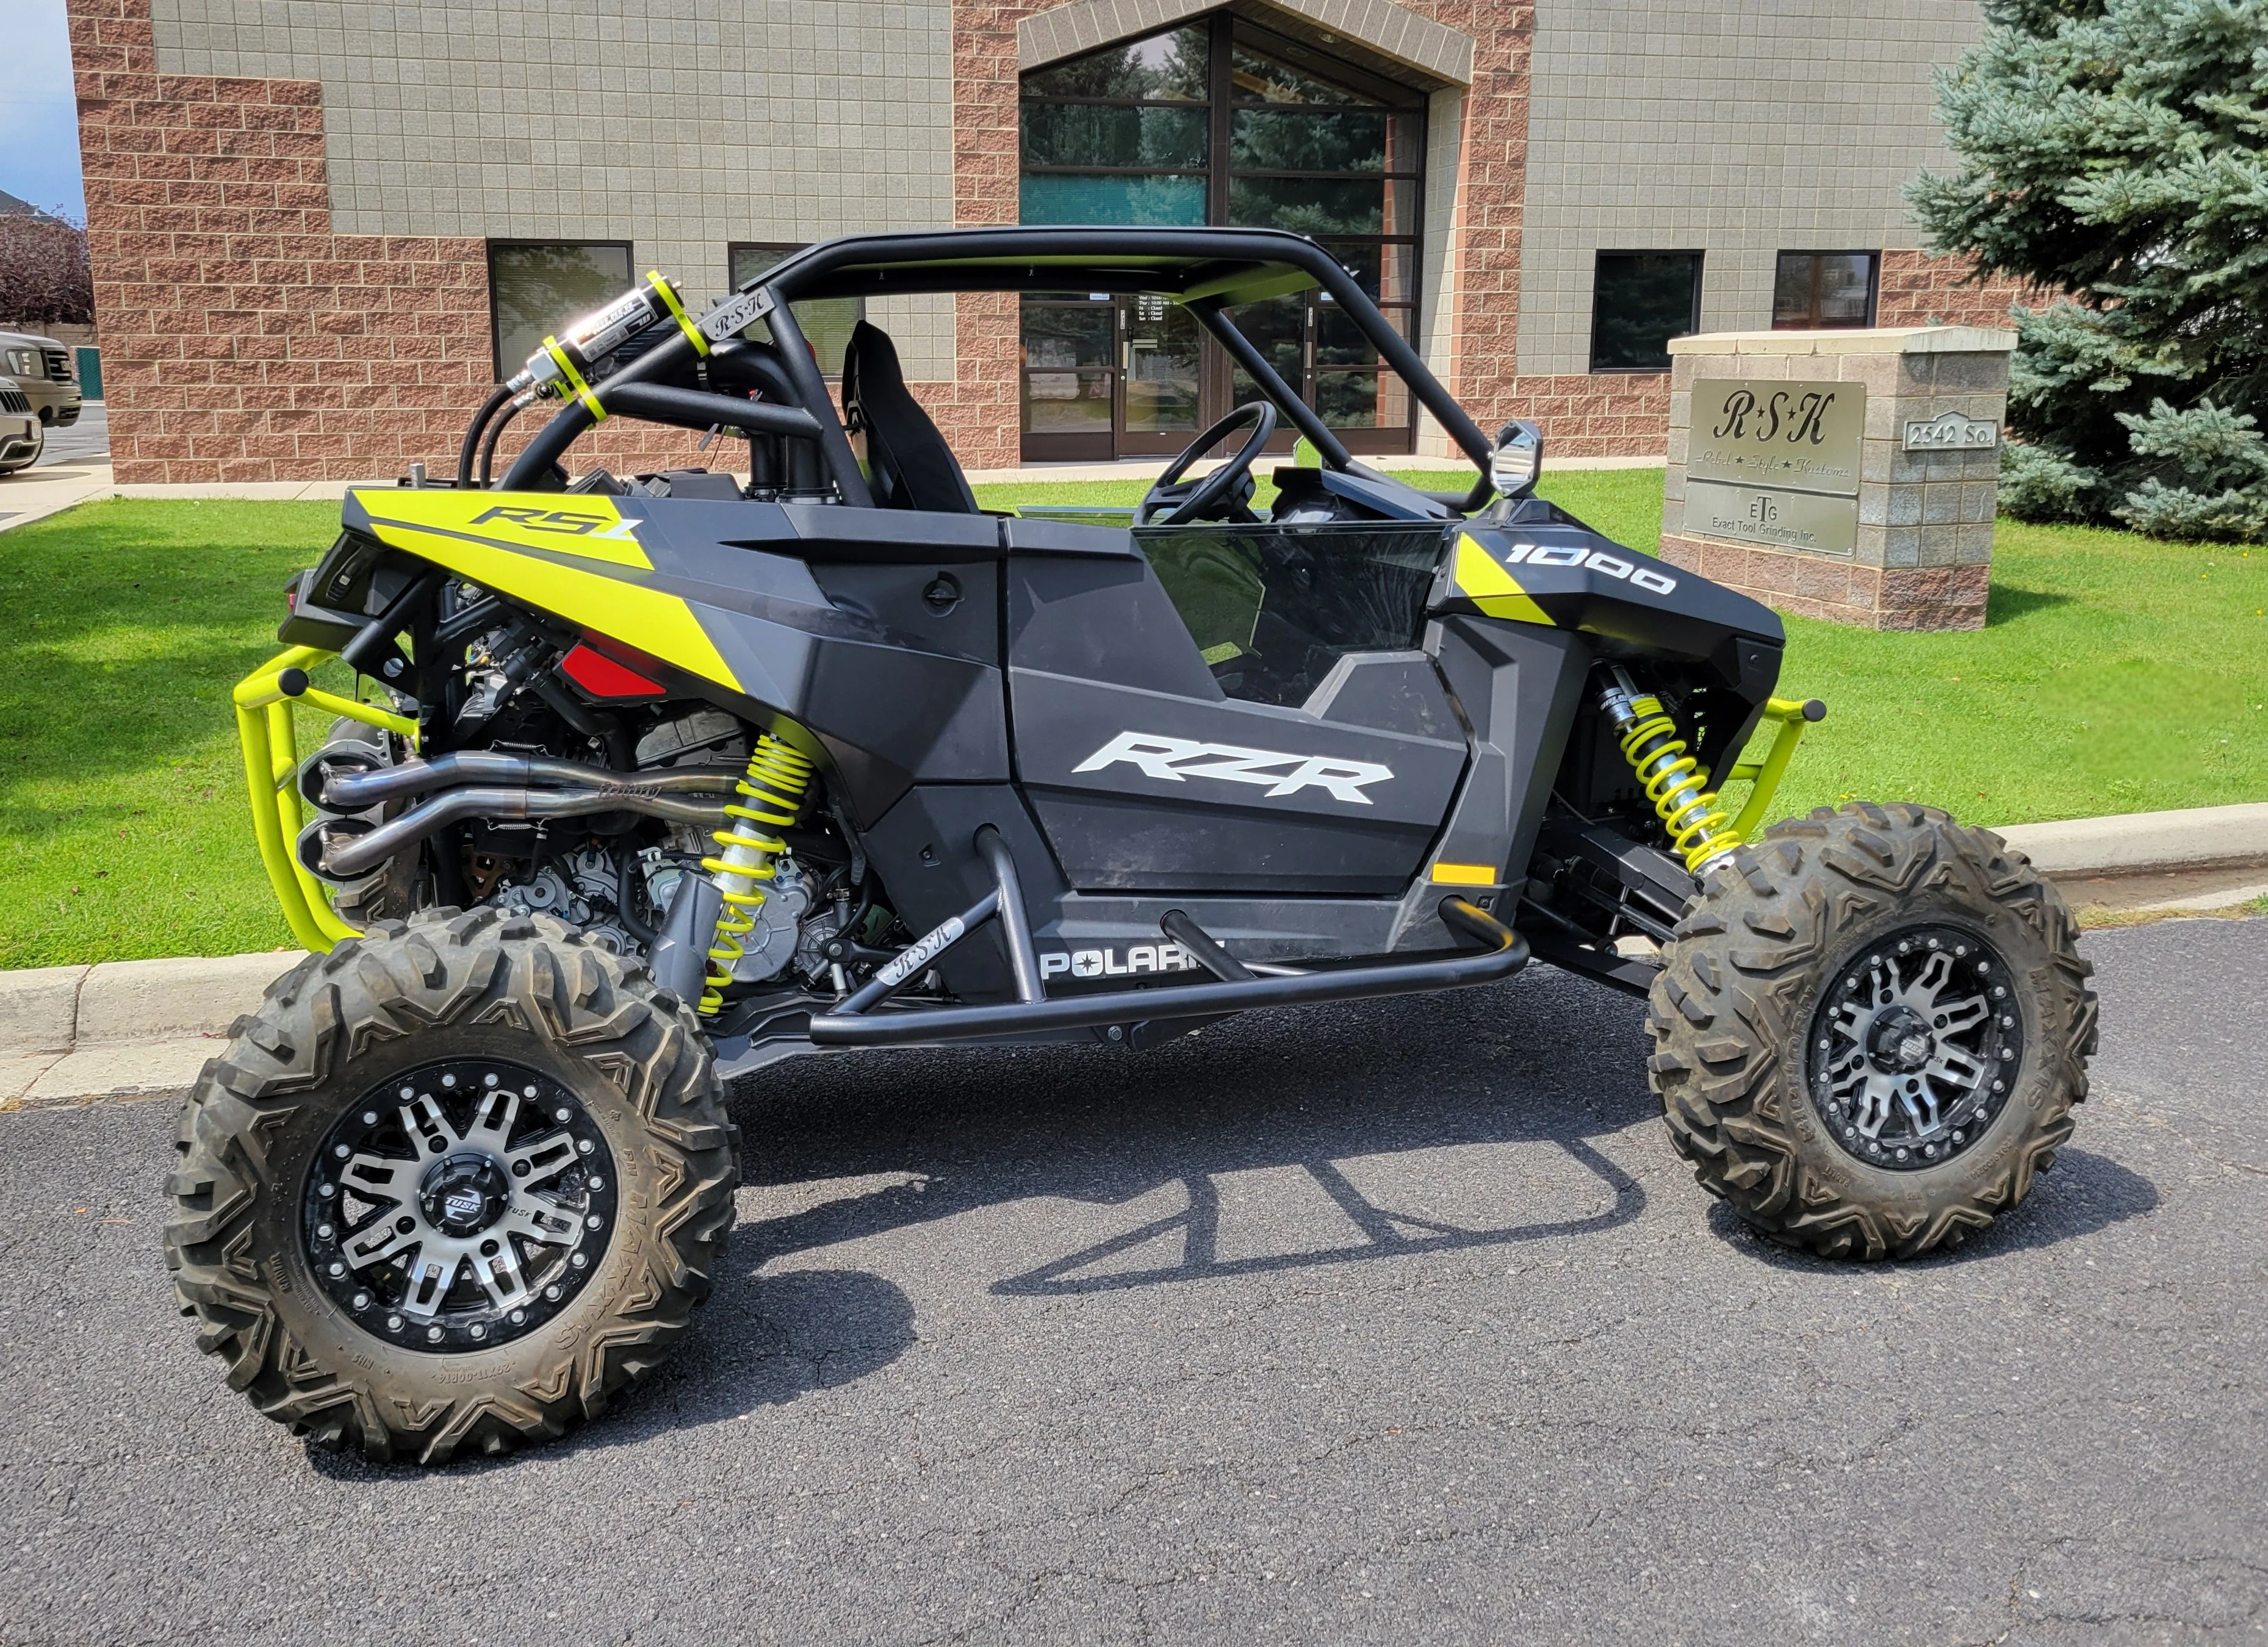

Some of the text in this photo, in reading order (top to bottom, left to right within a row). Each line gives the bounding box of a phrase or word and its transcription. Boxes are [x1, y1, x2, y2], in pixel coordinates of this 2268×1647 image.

[1909, 424, 1992, 444] 2542 So.
[1694, 450, 1851, 478] Rebel Style Kustoms
[1712, 517, 1817, 543] Exact Tool Grinding Inc.
[1504, 544, 1677, 595] 1000
[1071, 731, 1395, 805] RZR
[1040, 939, 1225, 980] POLAR
[1901, 1039, 1926, 1055] TUSK
[445, 1197, 481, 1211] TUSK
[507, 1205, 533, 1218] TUSK
